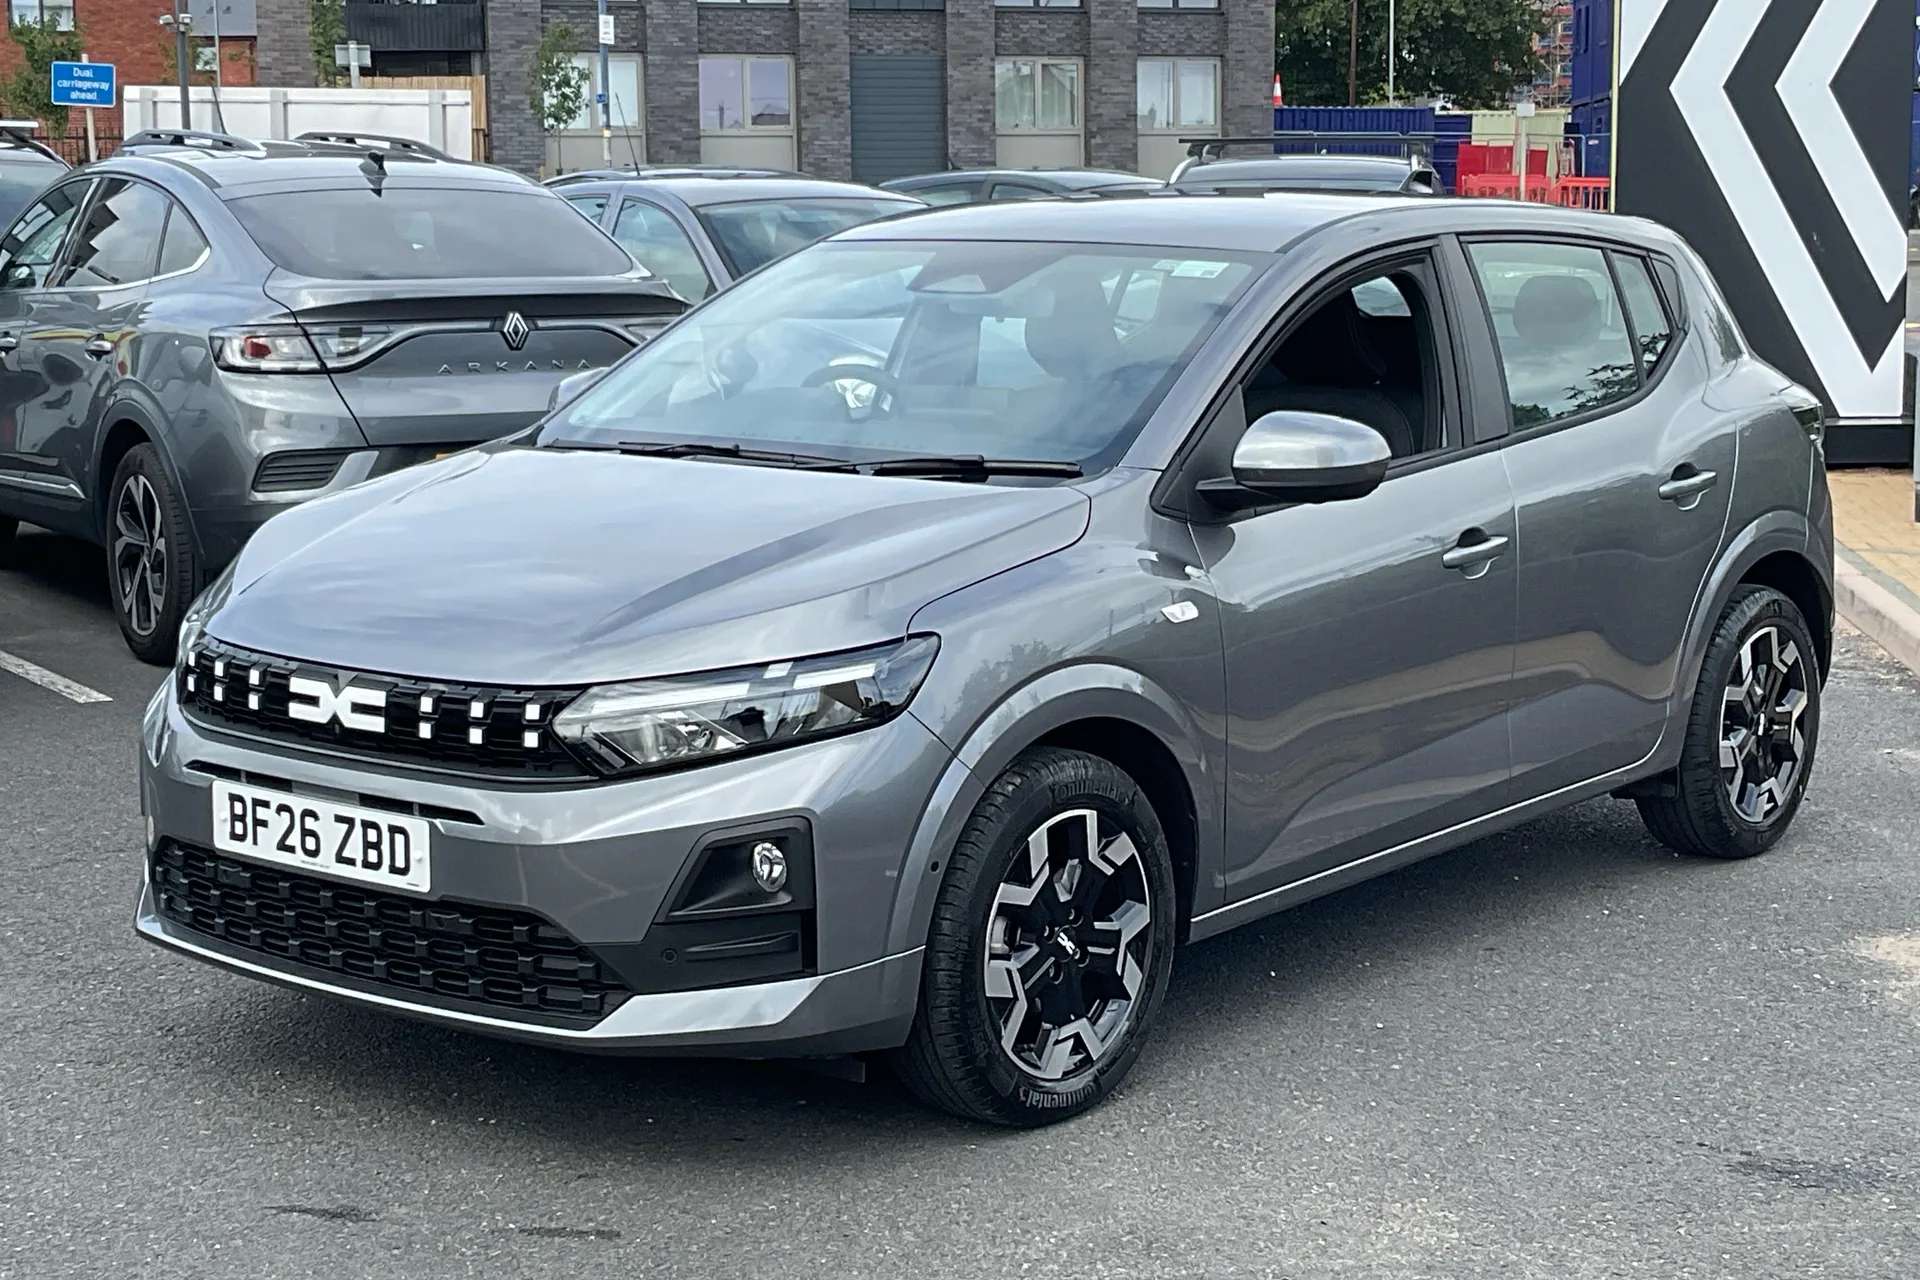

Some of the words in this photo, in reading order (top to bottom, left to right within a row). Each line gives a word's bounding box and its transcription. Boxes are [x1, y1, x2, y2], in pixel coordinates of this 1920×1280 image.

[72, 67, 94, 78] Dual
[57, 80, 110, 91] carriageway
[70, 90, 97, 100] ahead
[438, 359, 592, 375] ARKANA
[228, 792, 321, 858] BF26
[334, 813, 411, 876] ZBD
